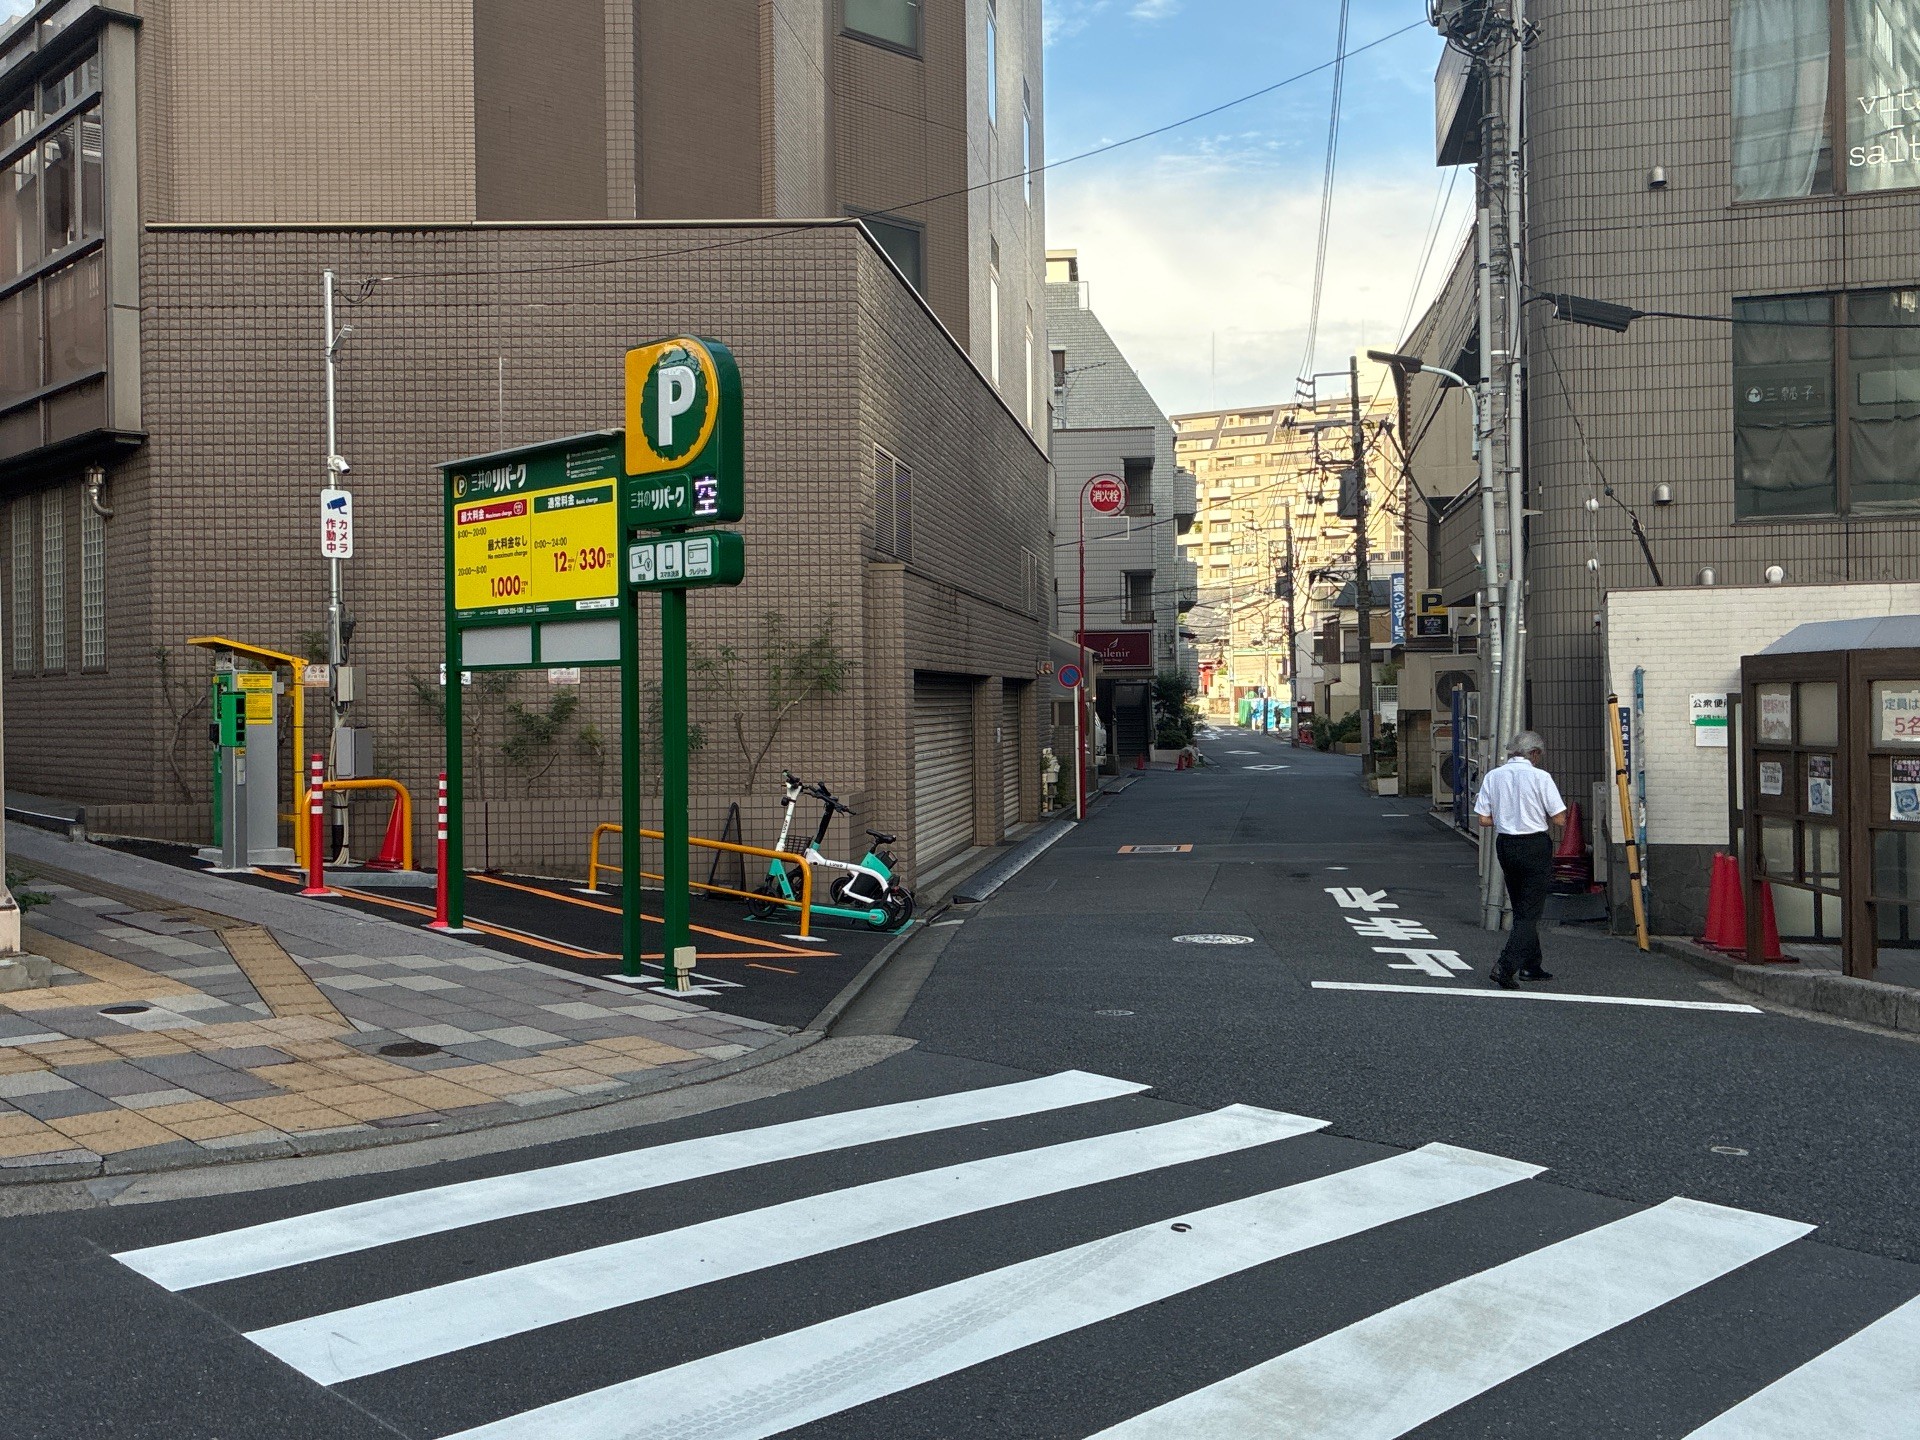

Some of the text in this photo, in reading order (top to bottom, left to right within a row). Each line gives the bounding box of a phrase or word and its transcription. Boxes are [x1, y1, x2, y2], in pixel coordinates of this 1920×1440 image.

[658, 365, 696, 447] P
[471, 464, 527, 492] 三井のリパーク
[630, 485, 685, 511] 三井のリパーク
[694, 476, 718, 515] 空
[1092, 489, 1120, 502] 消火栓
[325, 518, 337, 553] 作動中
[338, 519, 349, 553] カメラ
[487, 534, 528, 551] 最大料金なし
[553, 551, 567, 573] 12
[579, 546, 606, 571] 330
[490, 575, 520, 598] 1,000
